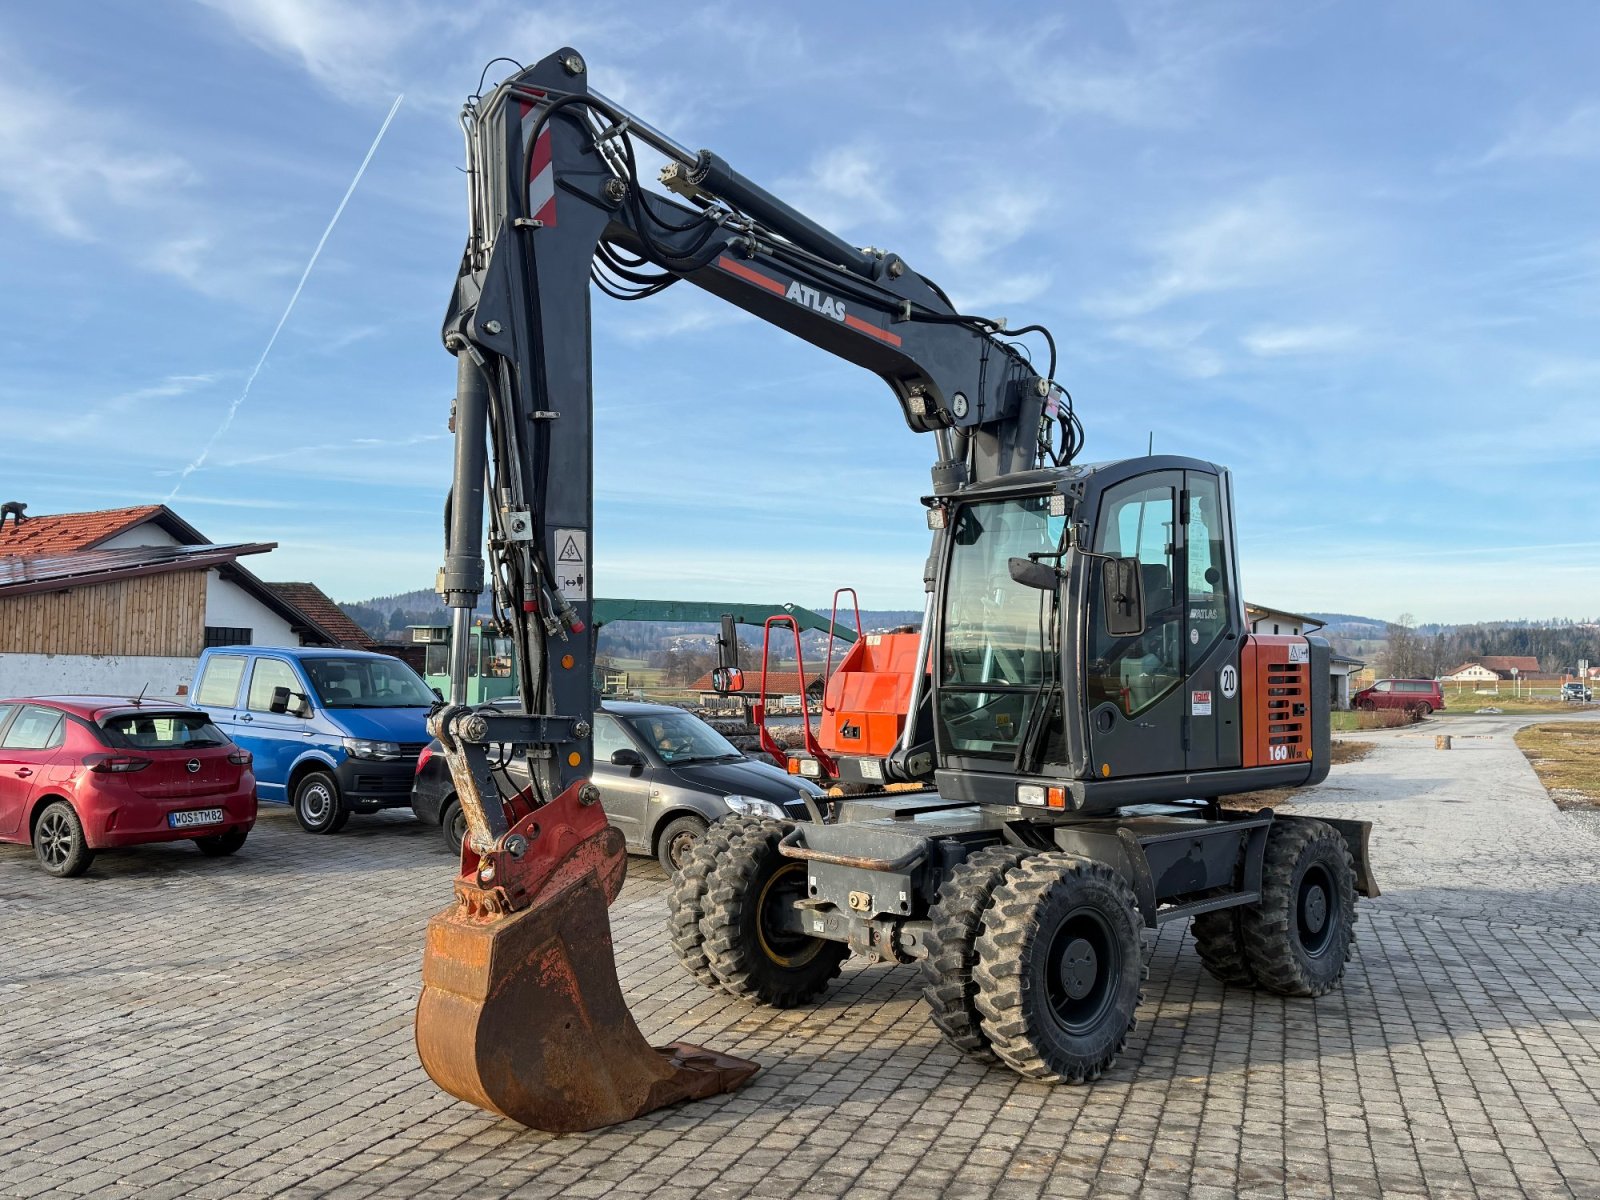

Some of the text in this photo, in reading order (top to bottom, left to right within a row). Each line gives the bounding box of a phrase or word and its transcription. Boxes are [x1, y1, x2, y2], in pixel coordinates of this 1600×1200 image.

[785, 281, 846, 321] ATLAS
[1195, 608, 1217, 619] ATLAS
[1224, 670, 1235, 691] 20
